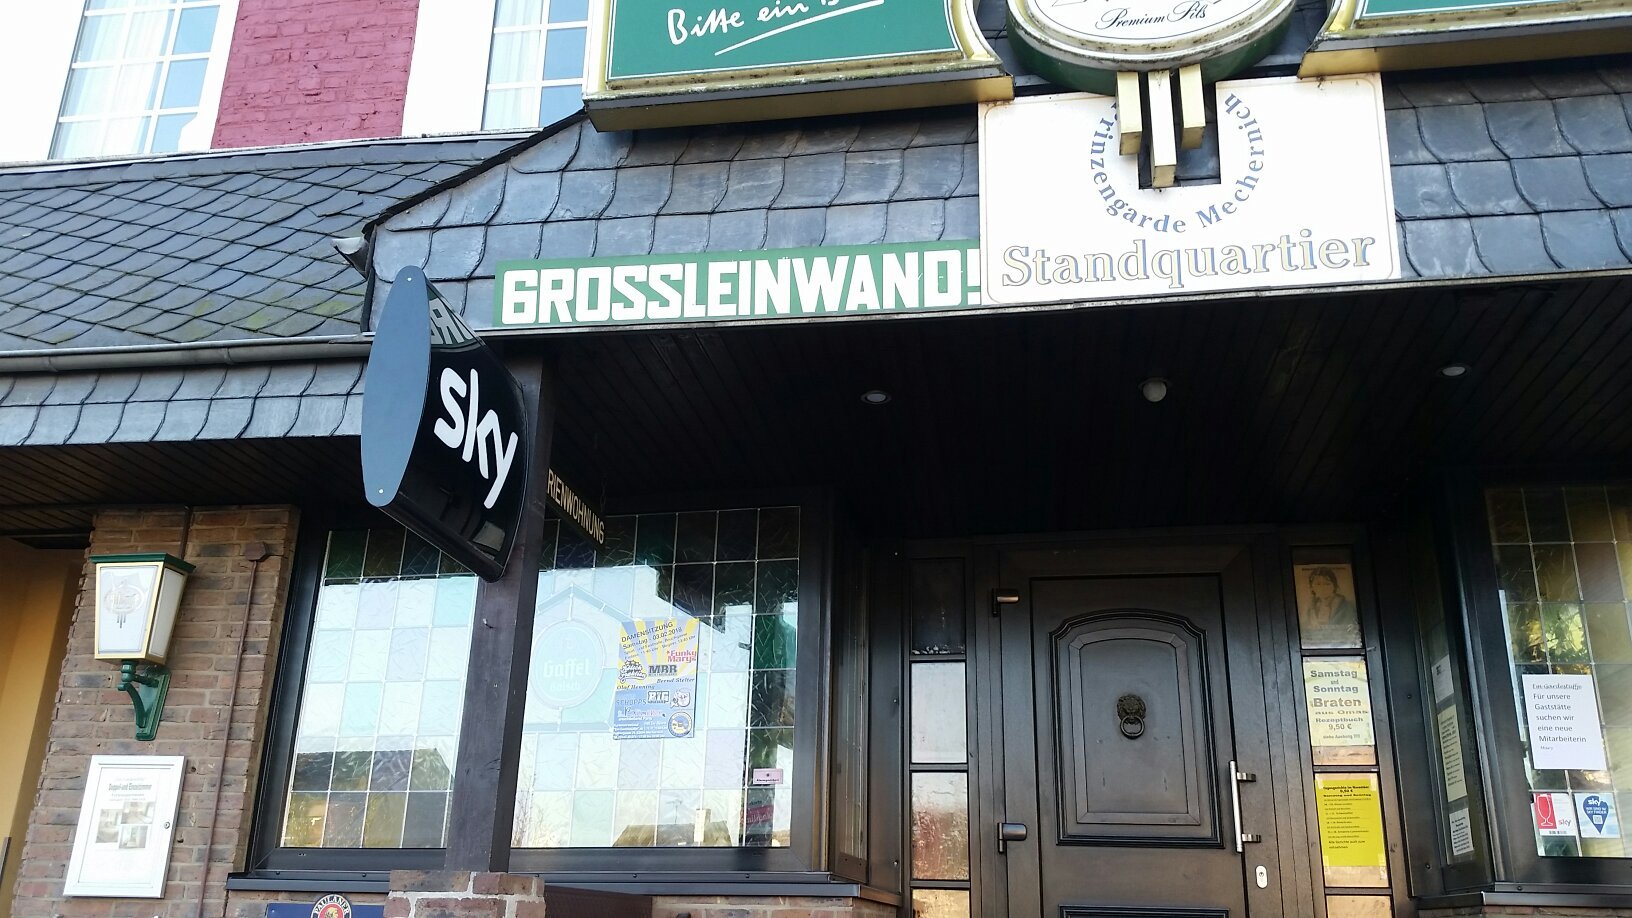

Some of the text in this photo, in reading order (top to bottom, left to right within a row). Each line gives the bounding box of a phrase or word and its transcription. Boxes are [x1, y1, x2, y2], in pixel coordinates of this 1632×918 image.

[756, 0, 801, 22] ein
[1094, 1, 1206, 30] Premium Pils
[1195, 92, 1265, 230] Mechernich
[1002, 228, 1376, 290] Standquartier
[501, 248, 981, 324] GROSSLEINWAND!
[433, 367, 519, 510] sky
[547, 468, 605, 544] RIENWOHNUNG
[621, 622, 673, 643] DAMENSITZUNG
[1311, 670, 1357, 678] Samstag
[1314, 685, 1358, 693] Sonntag
[1313, 698, 1361, 708] Braten
[1539, 735, 1587, 743] Mitarbeiterin
[1588, 798, 1601, 806] sky
[1559, 819, 1572, 827] sky
[314, 896, 349, 914] PAULANER
